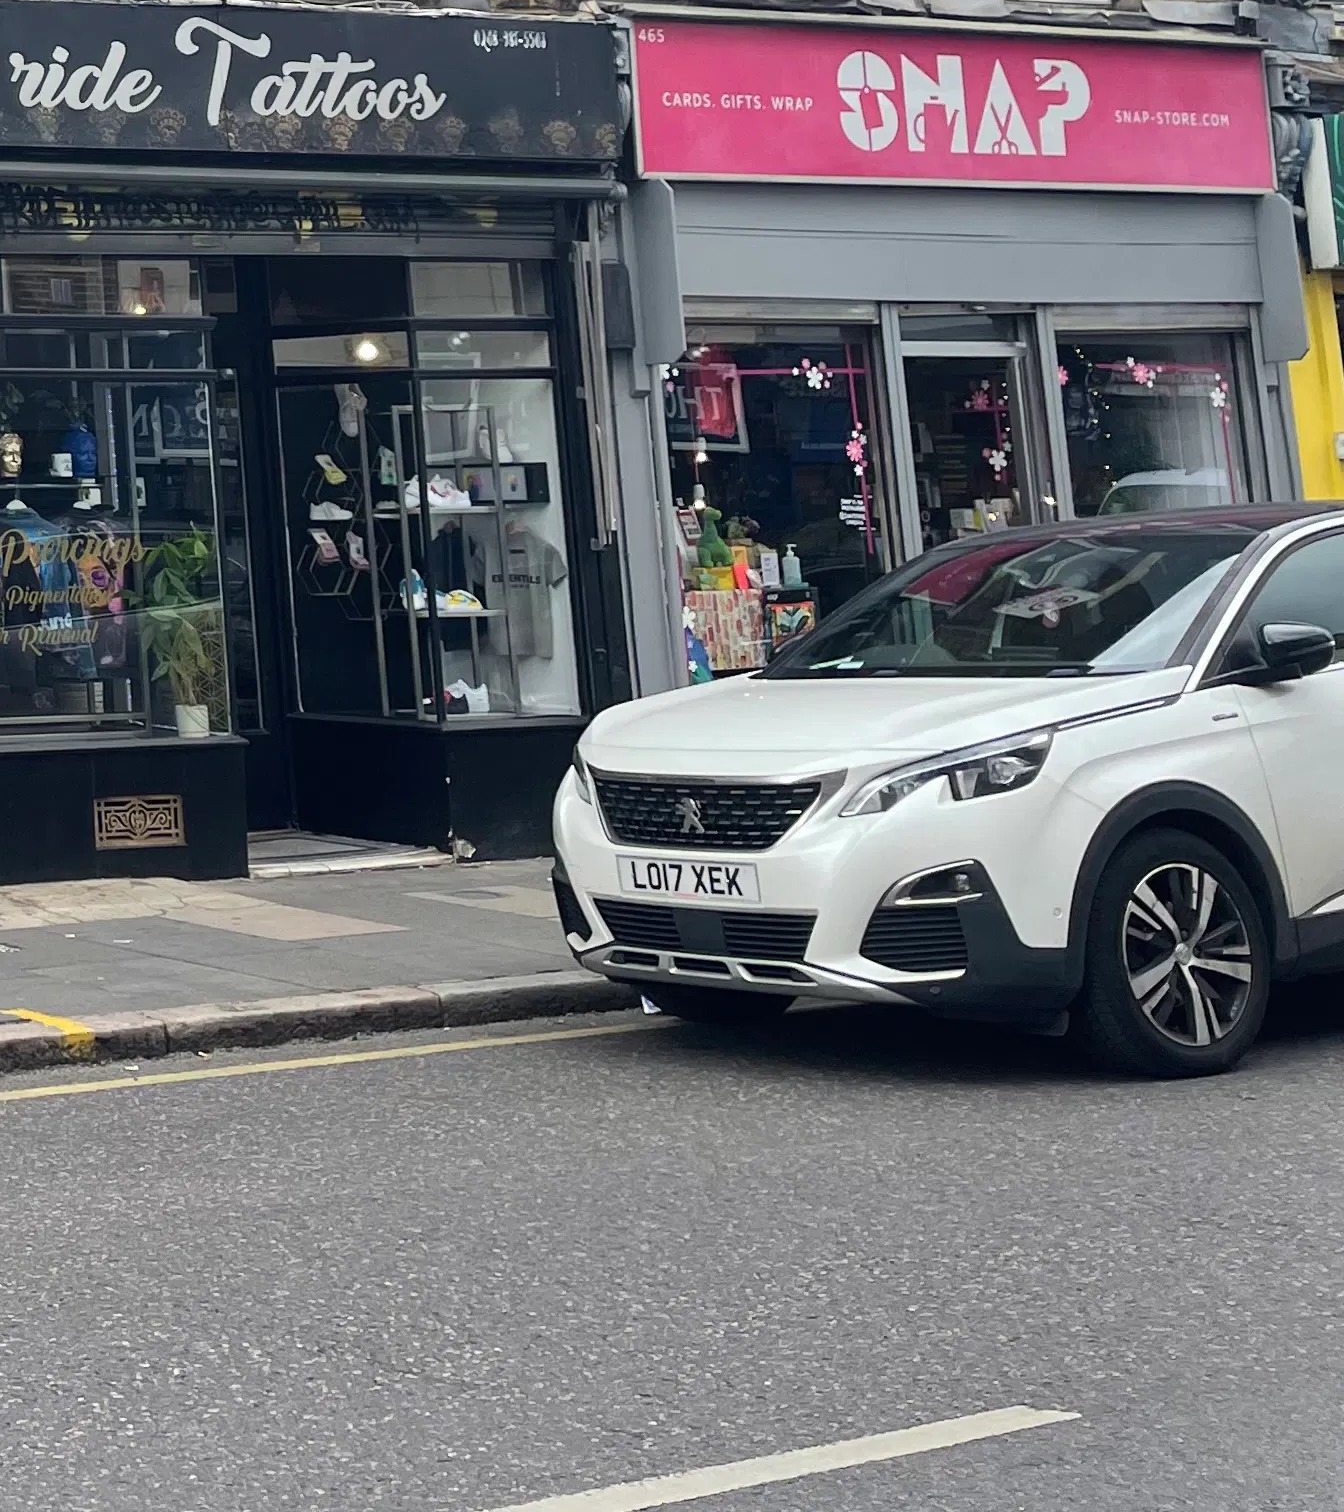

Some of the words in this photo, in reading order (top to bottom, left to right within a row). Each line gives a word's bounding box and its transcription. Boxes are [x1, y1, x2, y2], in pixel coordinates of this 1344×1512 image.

[638, 28, 665, 43] 465
[174, 16, 447, 127] Tattoos
[771, 96, 813, 112] WRAP
[836, 50, 1092, 157] SNAP
[1114, 109, 1230, 127] SNAP-STORE.COM
[631, 859, 683, 892] LO17
[691, 864, 744, 896] XEK
